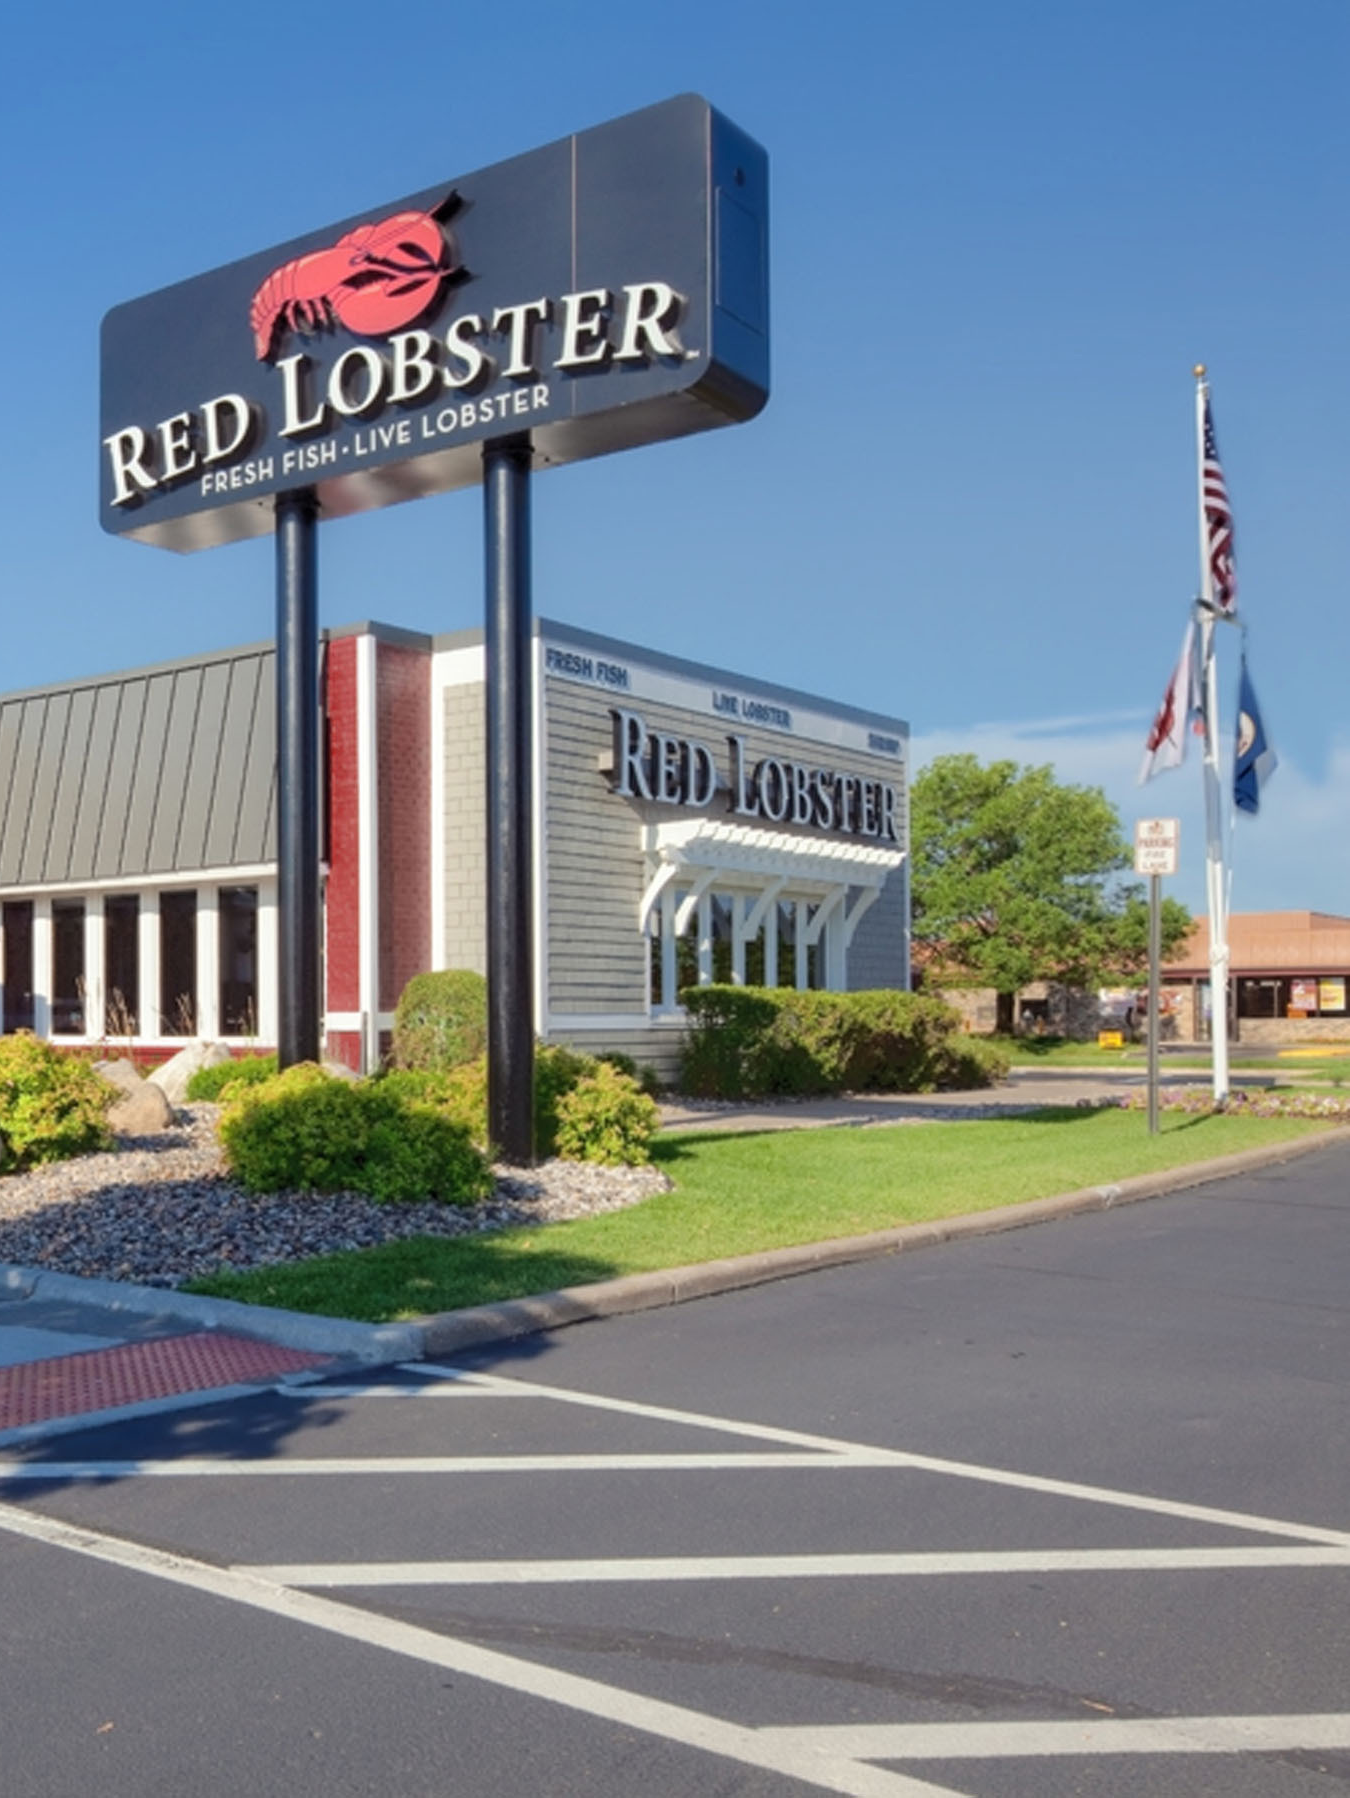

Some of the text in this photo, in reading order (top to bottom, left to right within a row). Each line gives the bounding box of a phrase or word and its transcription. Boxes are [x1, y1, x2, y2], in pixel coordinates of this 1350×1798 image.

[103, 281, 678, 505] RED LOBSTER
[200, 385, 551, 498] FRESH FISH LIVE LOBSTER
[545, 648, 629, 688] FRESH FISH
[742, 699, 791, 729] LOBSTER
[609, 709, 899, 840] RED LOBSTER
